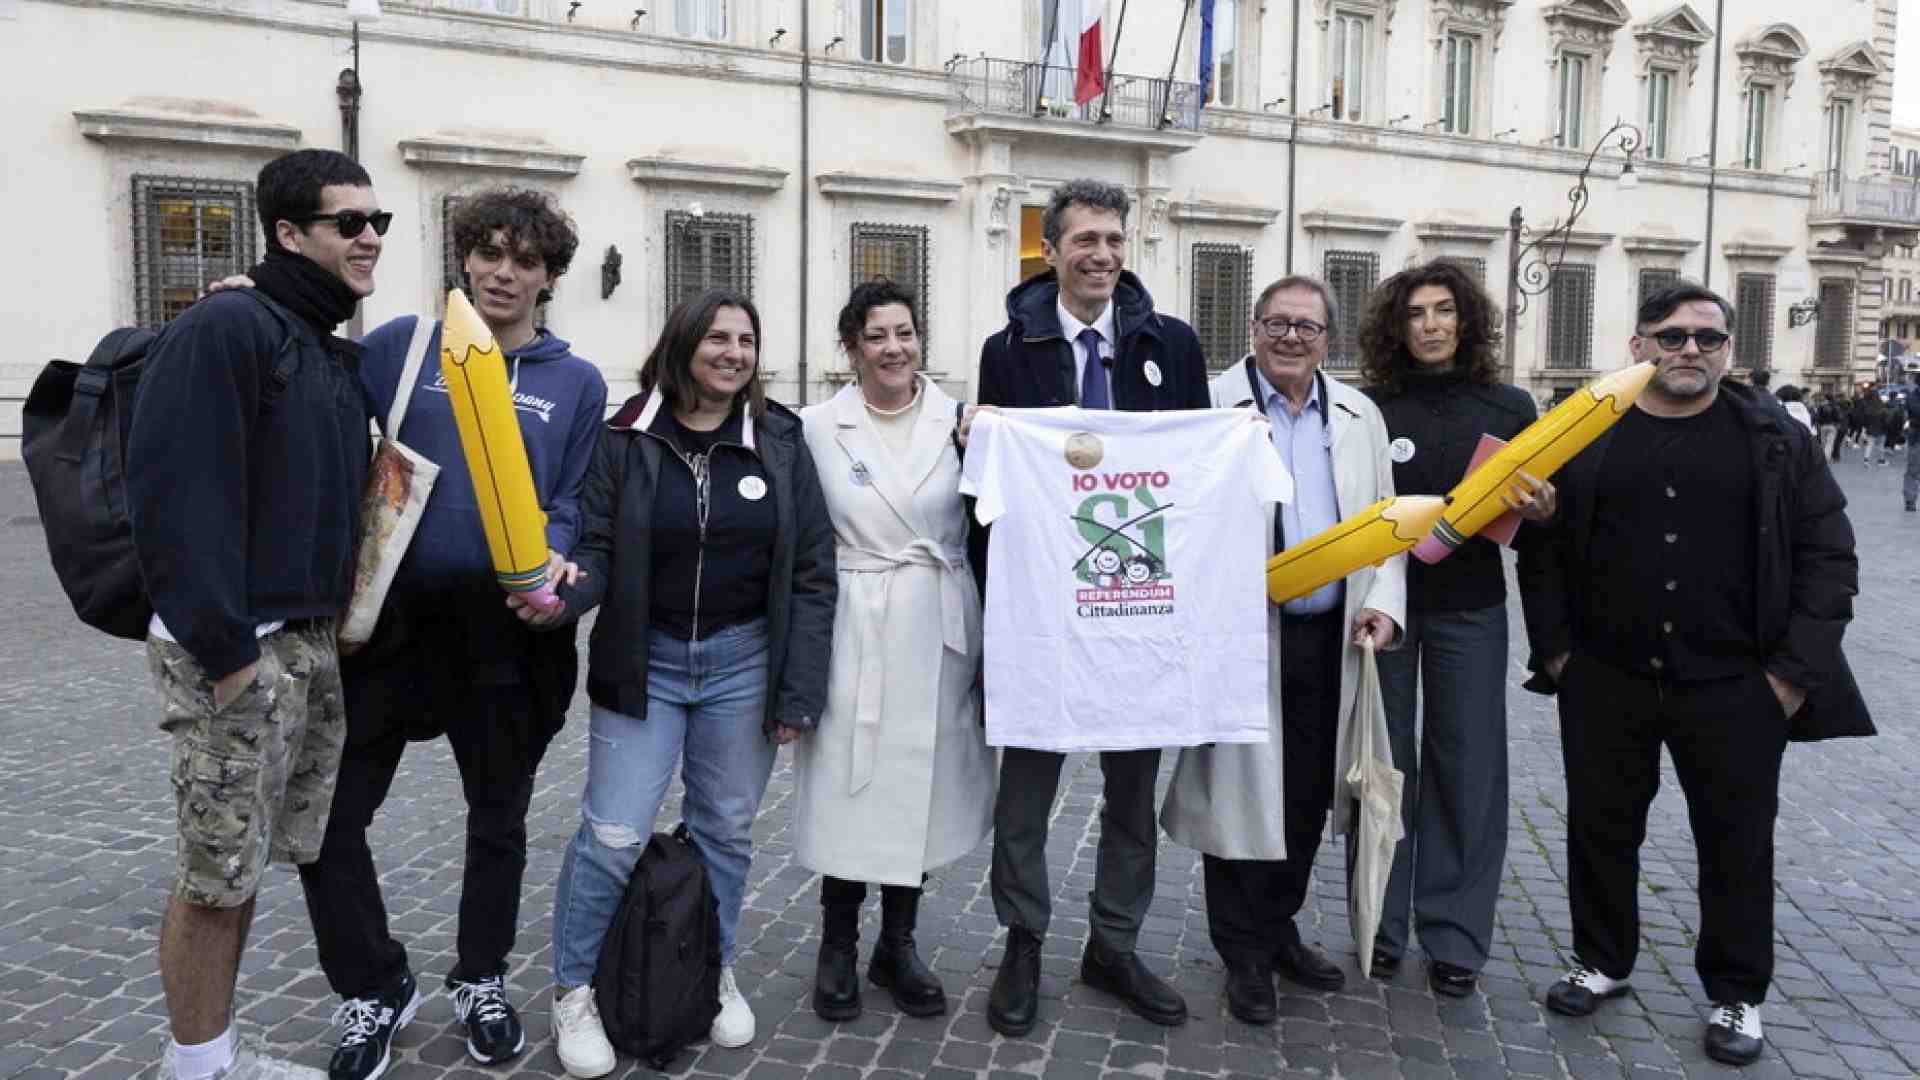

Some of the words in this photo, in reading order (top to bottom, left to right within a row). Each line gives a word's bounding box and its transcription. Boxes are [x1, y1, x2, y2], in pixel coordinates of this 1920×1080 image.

[1073, 474, 1097, 491] IO
[1103, 472, 1170, 490] VOTO
[1078, 587, 1171, 601] REFERENDUM
[1077, 602, 1173, 617] Cittadinanza
